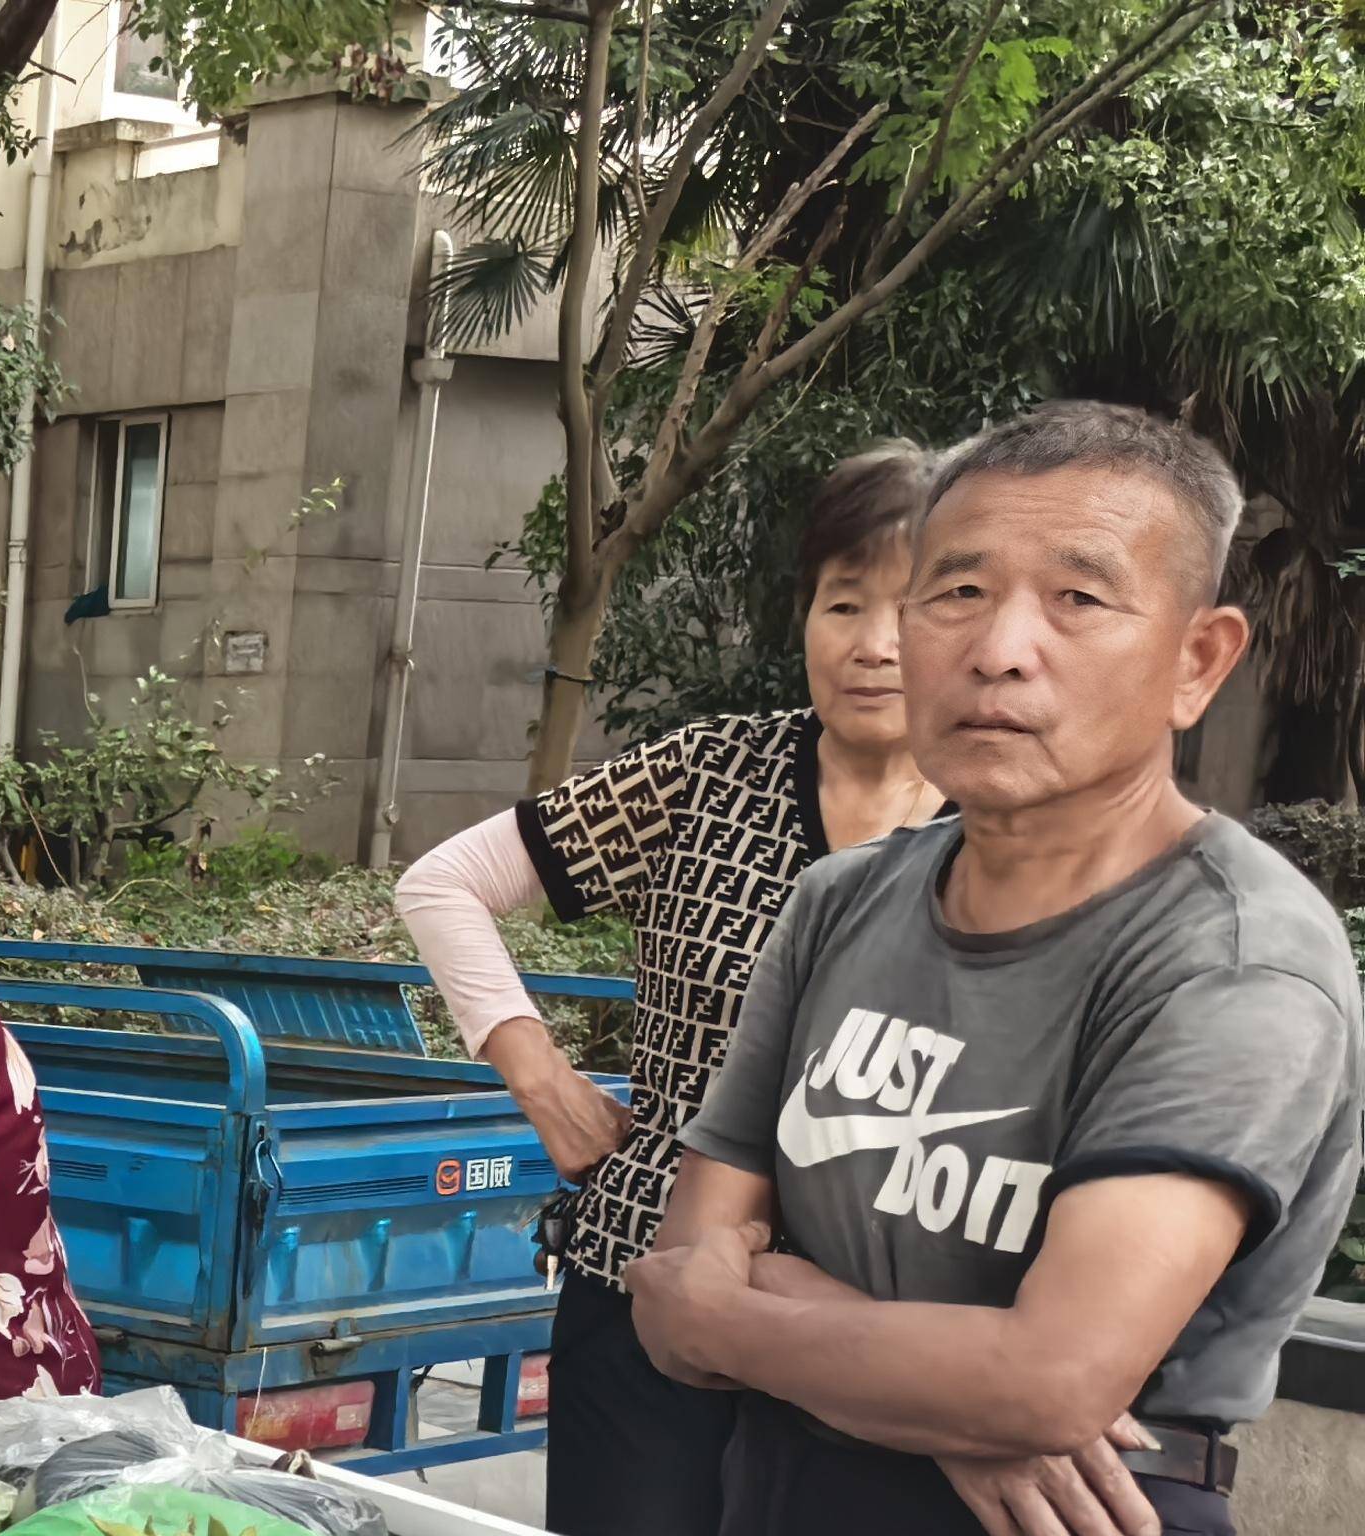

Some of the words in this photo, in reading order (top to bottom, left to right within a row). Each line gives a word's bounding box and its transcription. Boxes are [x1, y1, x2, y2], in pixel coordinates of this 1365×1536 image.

[809, 1008, 966, 1116] JUST
[465, 1155, 514, 1192] 国威
[873, 1136, 970, 1233] DO
[963, 1155, 1053, 1254] IT
